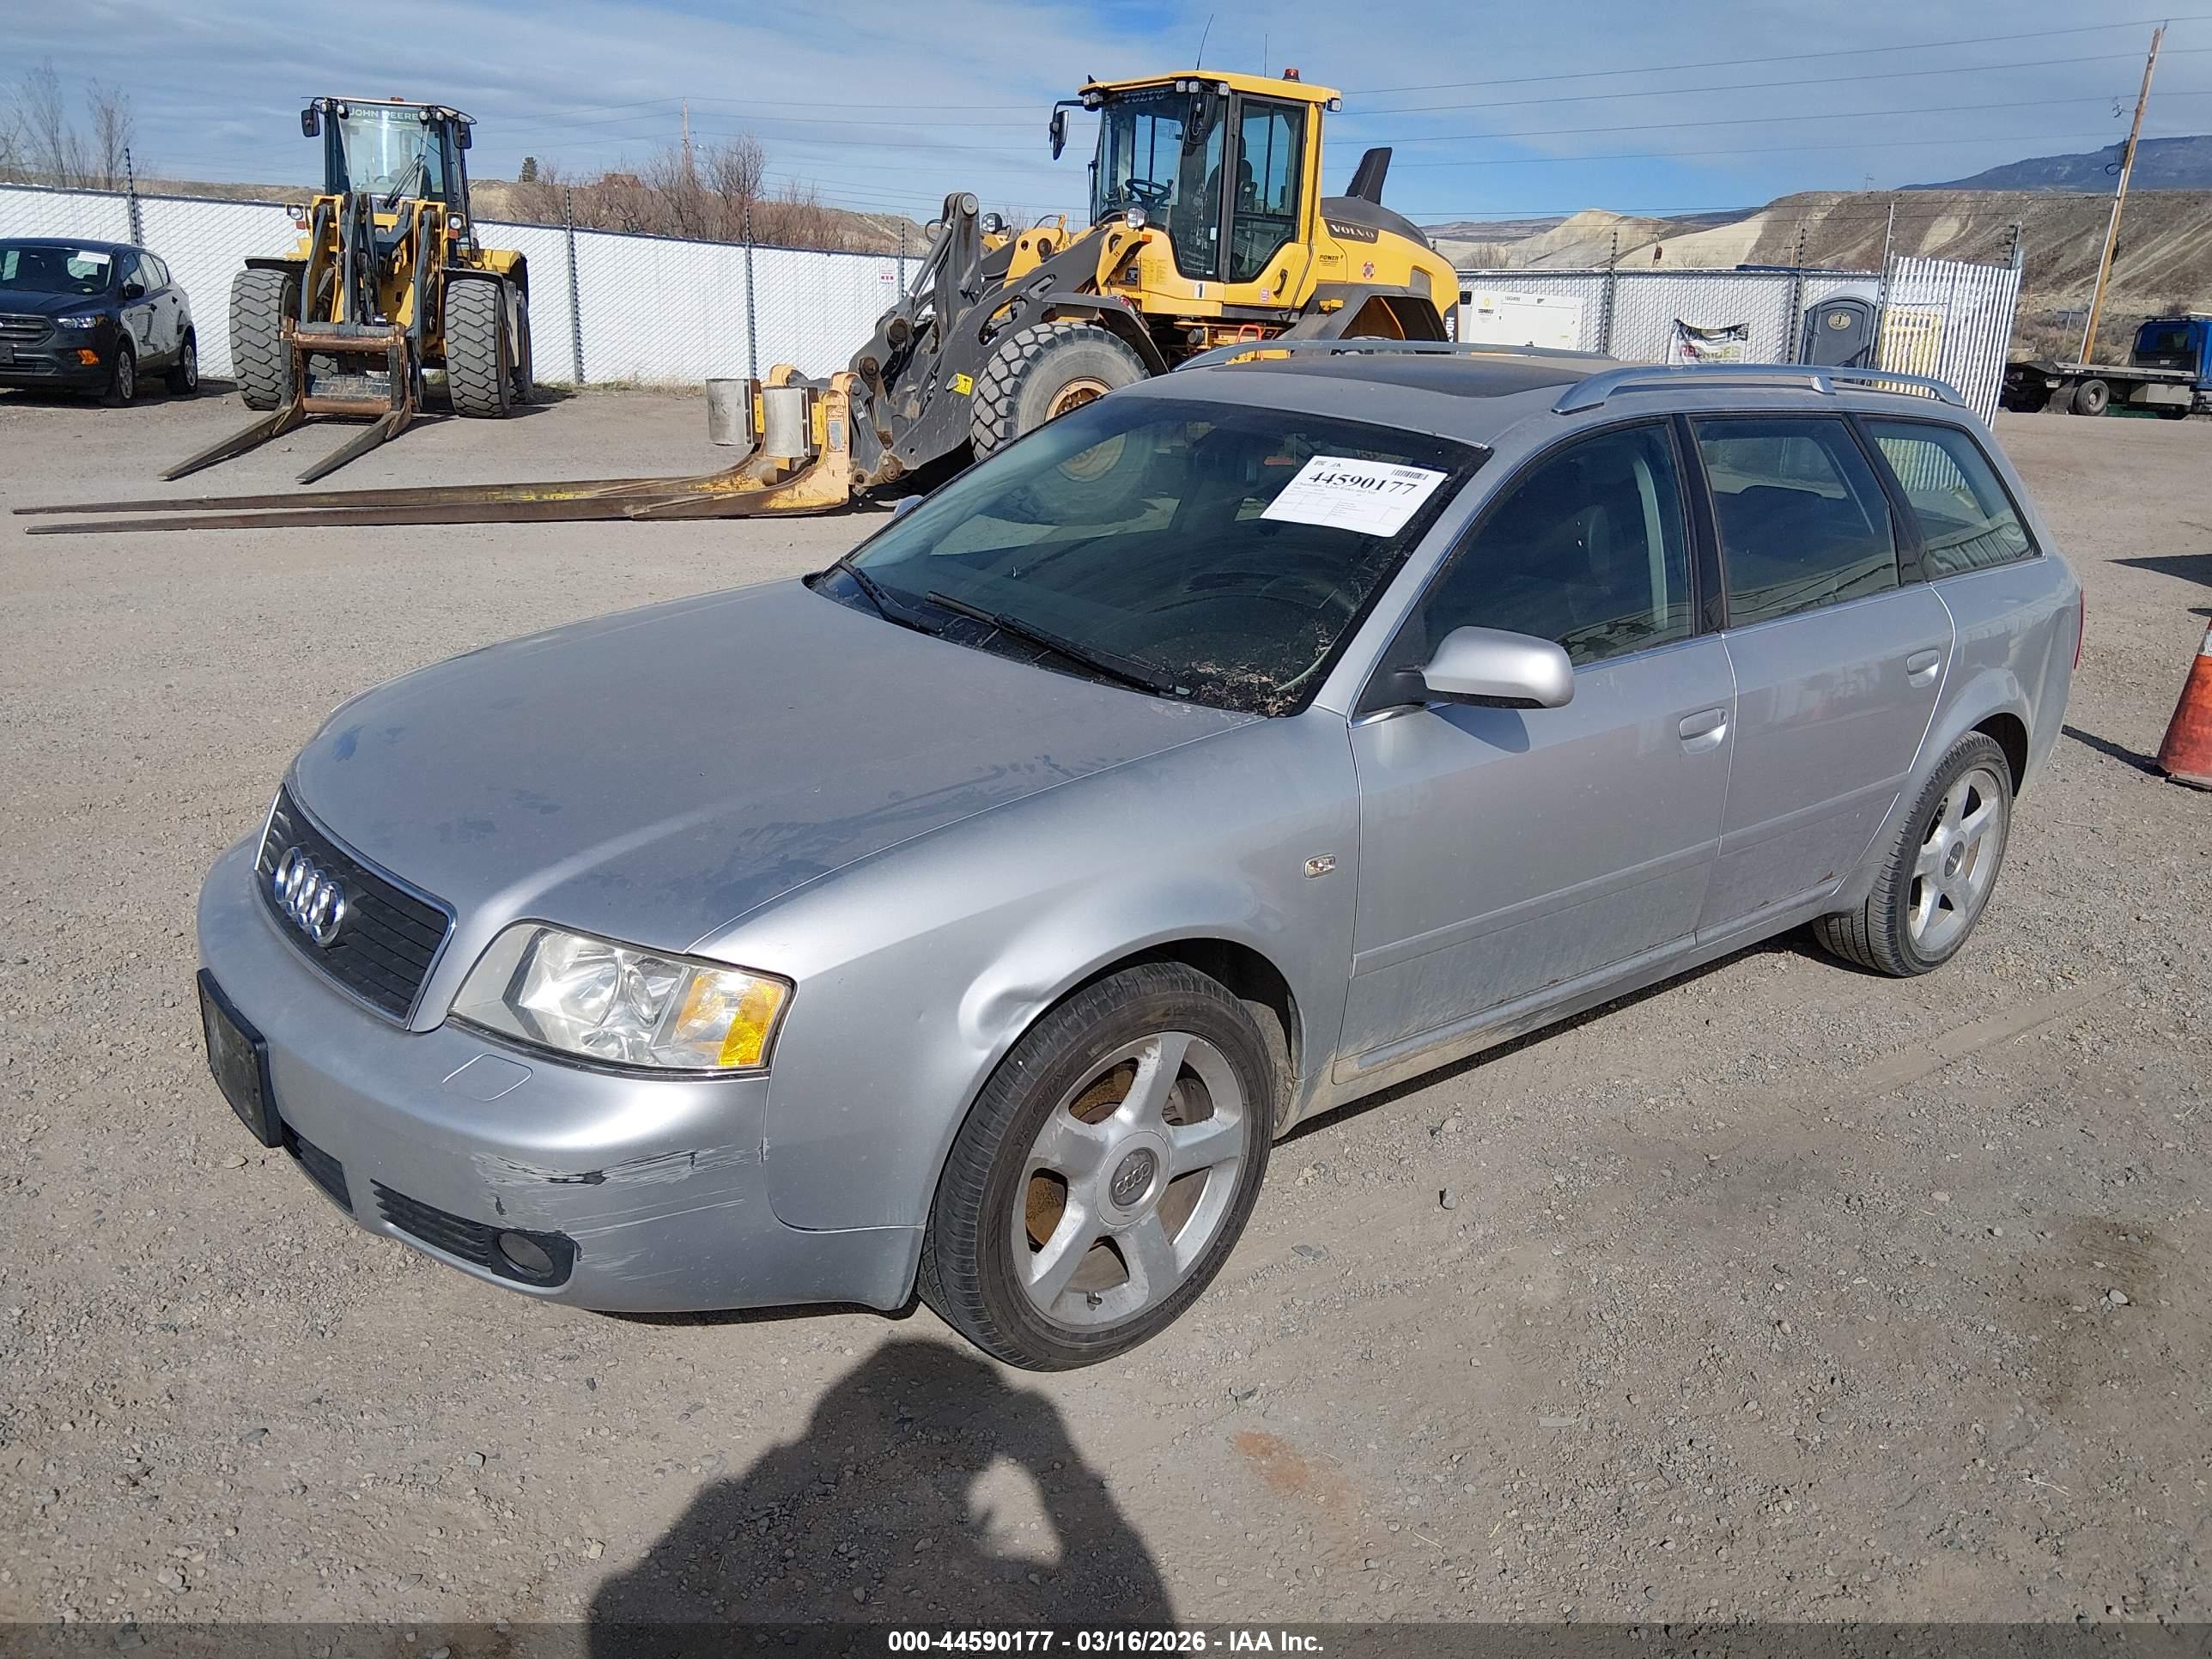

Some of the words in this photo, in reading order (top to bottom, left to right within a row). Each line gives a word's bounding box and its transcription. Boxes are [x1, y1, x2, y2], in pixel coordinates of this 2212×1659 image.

[349, 106, 379, 118] JOHN
[381, 110, 419, 121] DEERE
[1330, 224, 1375, 238] VOLVO
[1309, 471, 1419, 495] 44590177
